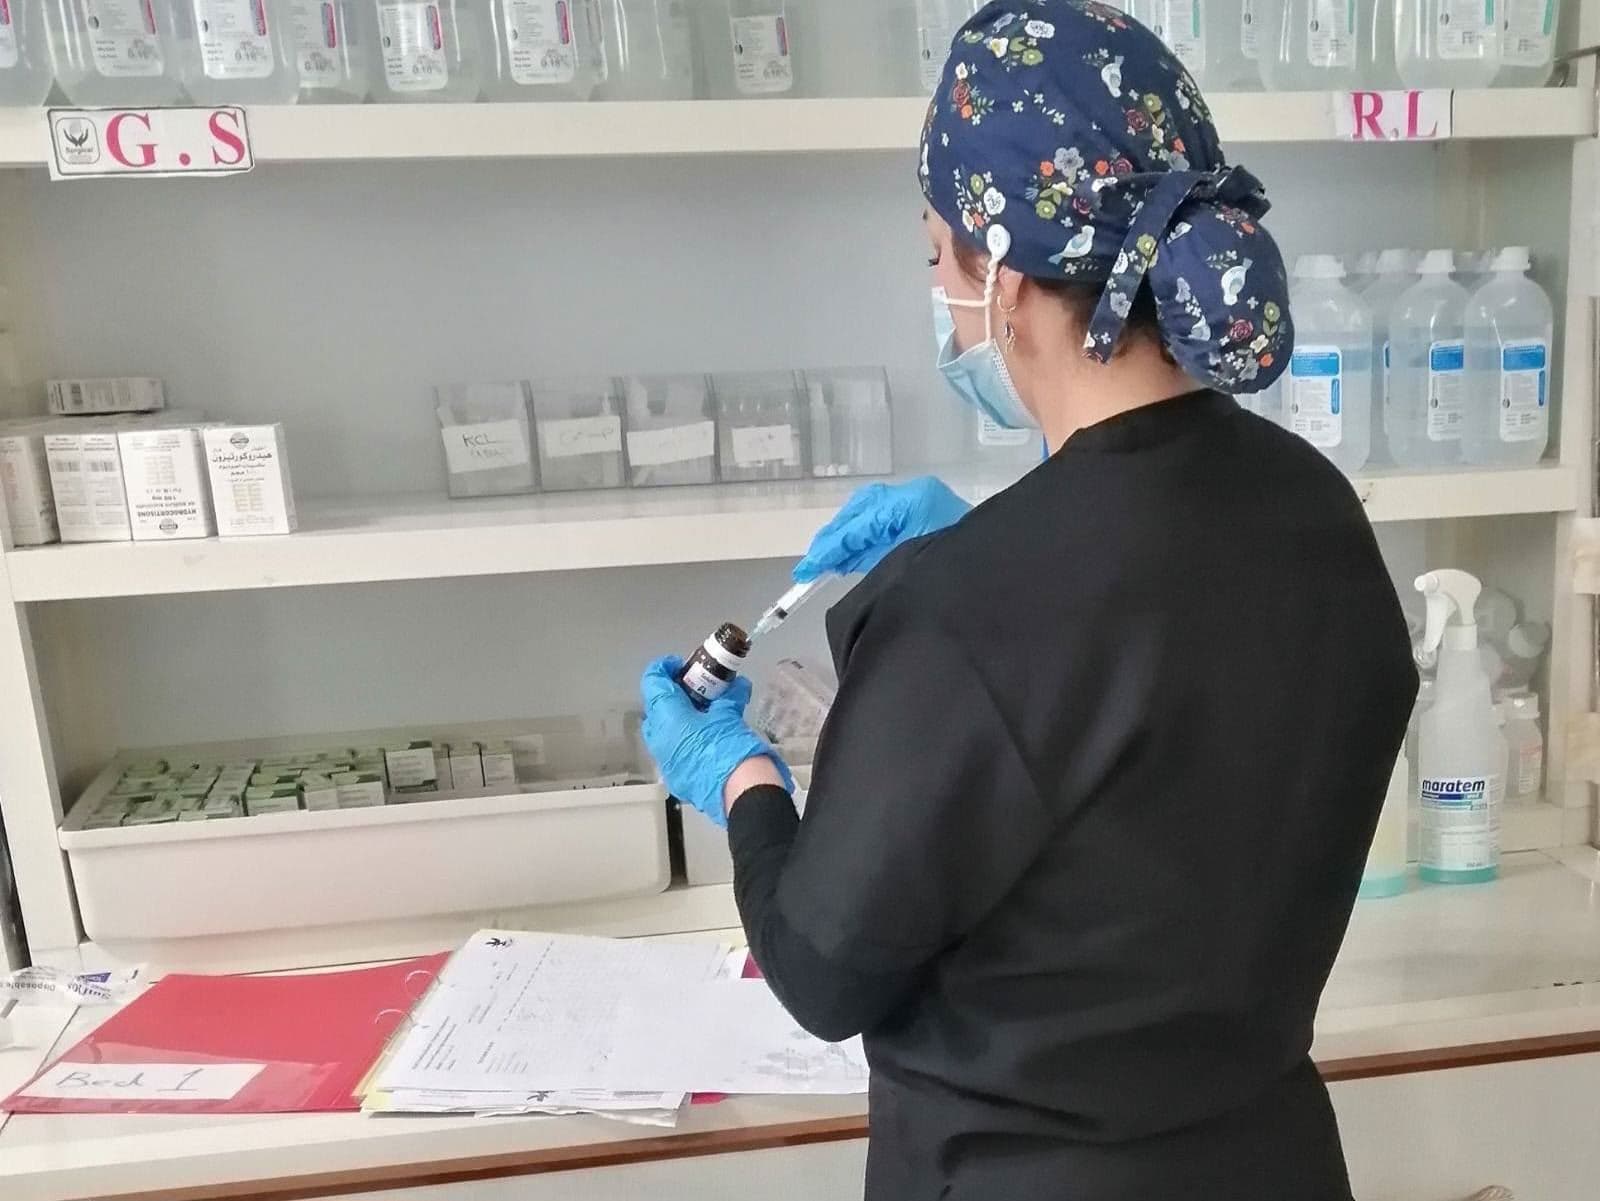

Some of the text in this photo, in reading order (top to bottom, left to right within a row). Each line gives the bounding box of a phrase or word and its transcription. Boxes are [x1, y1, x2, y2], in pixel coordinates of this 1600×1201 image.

[65, 146, 94, 155] Surgical
[137, 508, 197, 517] HYDROCORTISONE
[1422, 779, 1485, 793] maratem
[156, 1067, 204, 1092] 1
